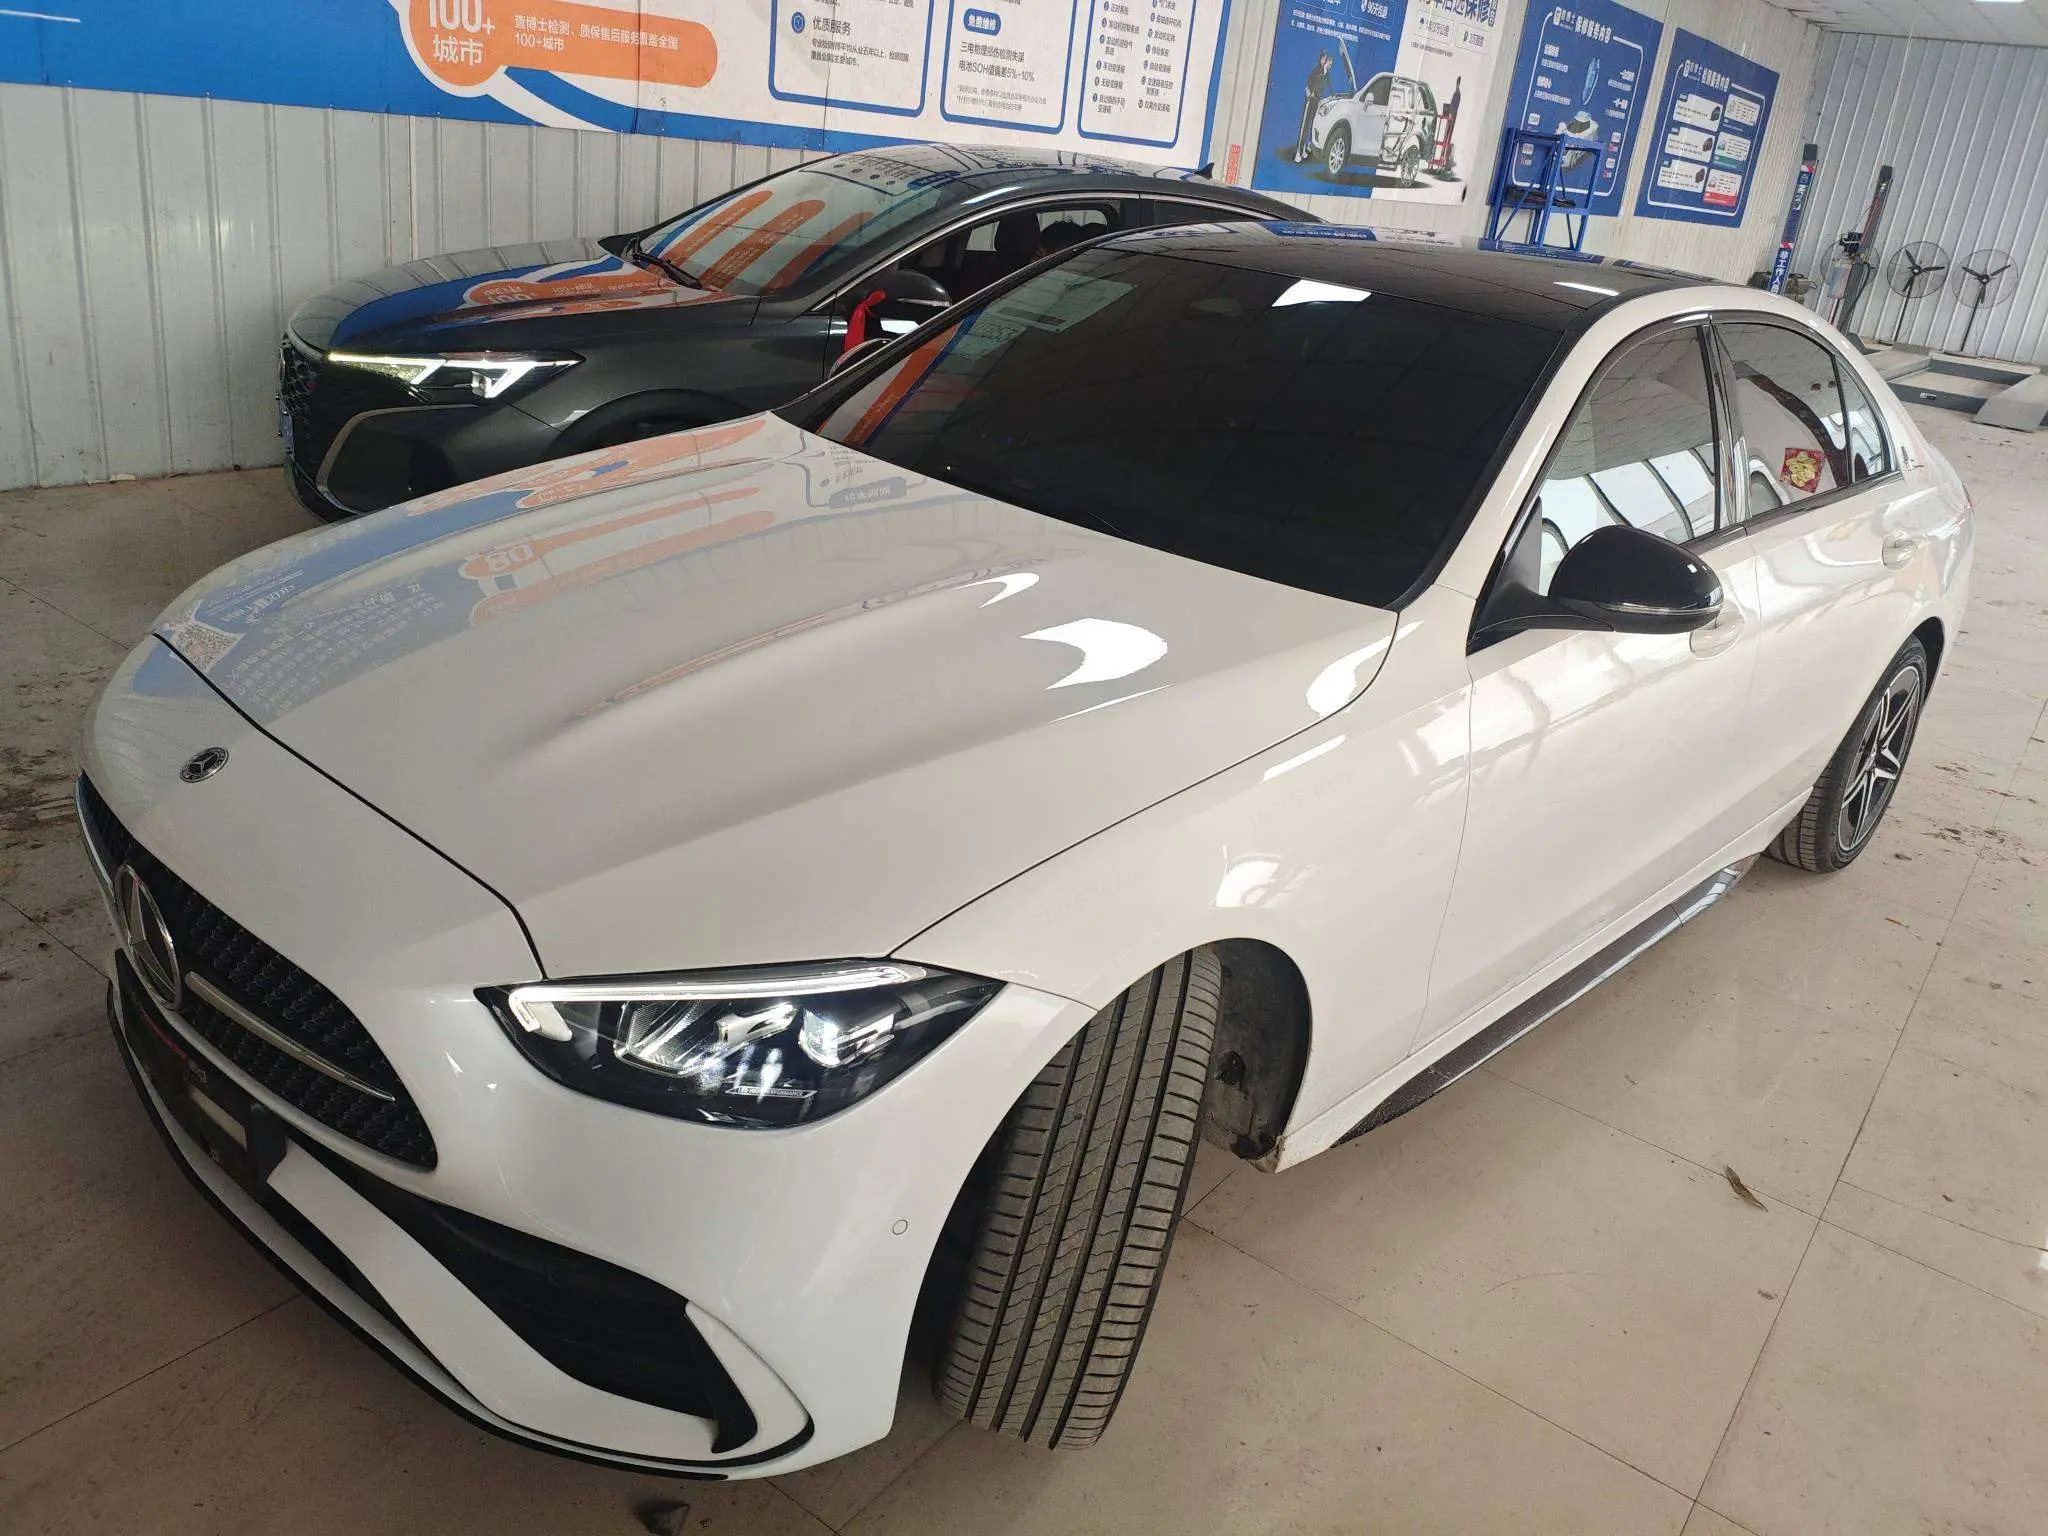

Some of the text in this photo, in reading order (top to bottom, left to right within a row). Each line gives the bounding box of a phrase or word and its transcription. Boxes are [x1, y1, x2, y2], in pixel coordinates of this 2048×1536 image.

[429, 0, 496, 36] 100+
[812, 16, 851, 36] 优质服务
[433, 33, 484, 66] 城市
